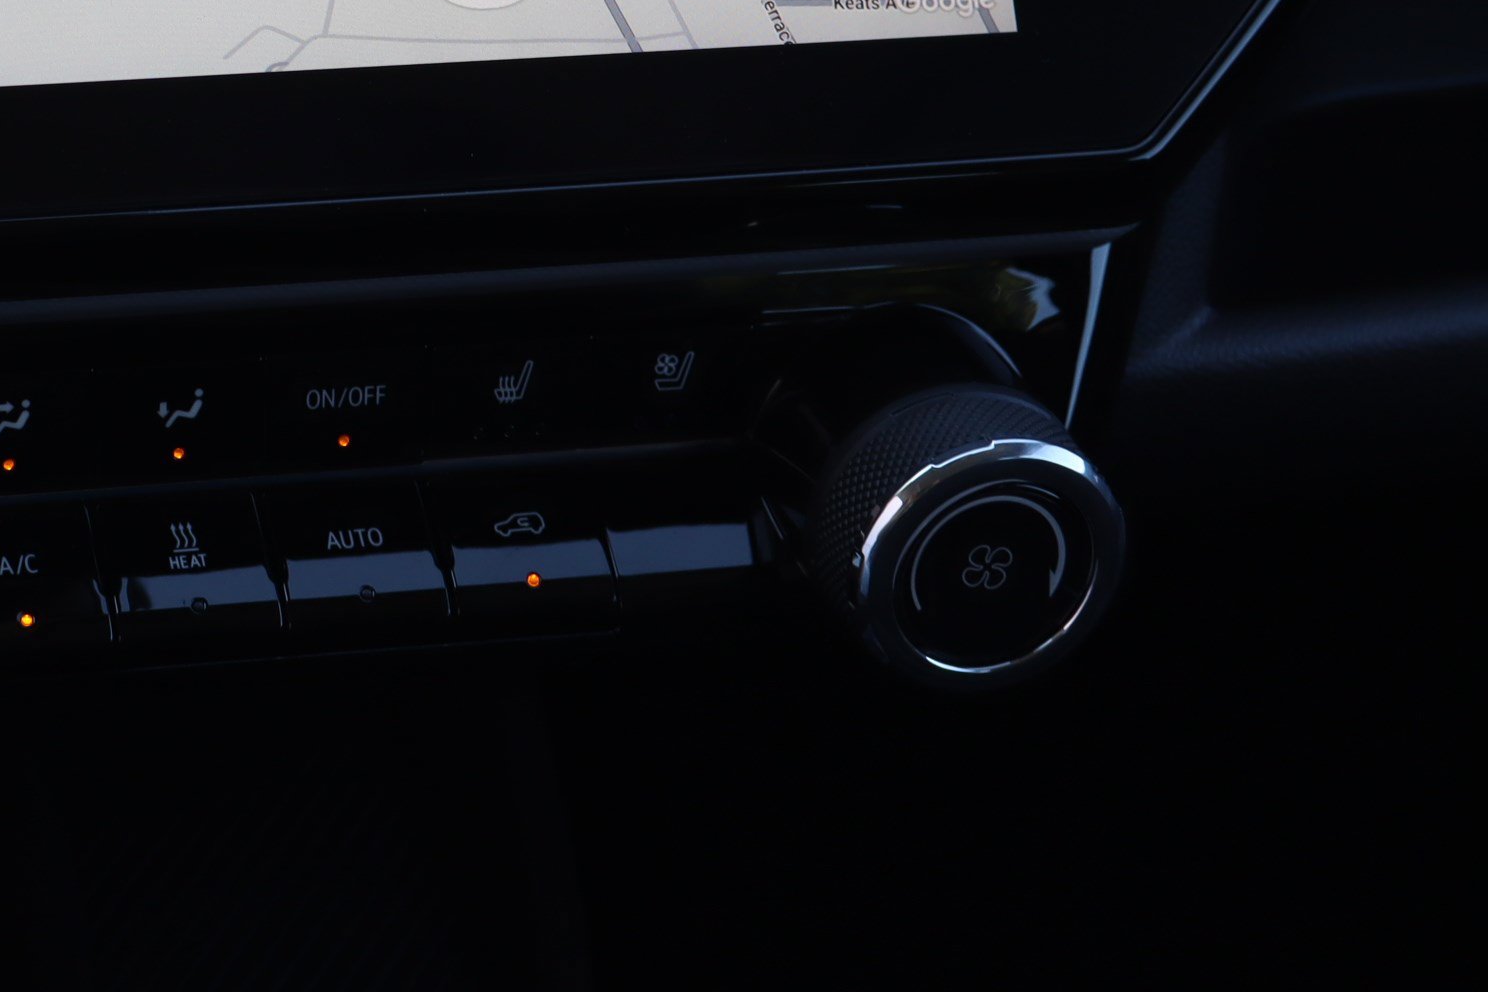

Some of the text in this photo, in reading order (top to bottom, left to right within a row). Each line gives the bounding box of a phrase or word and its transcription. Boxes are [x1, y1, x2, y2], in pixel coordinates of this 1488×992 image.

[305, 384, 387, 410] ON/OFF
[326, 526, 384, 550] AUTO
[168, 552, 207, 570] HEAT
